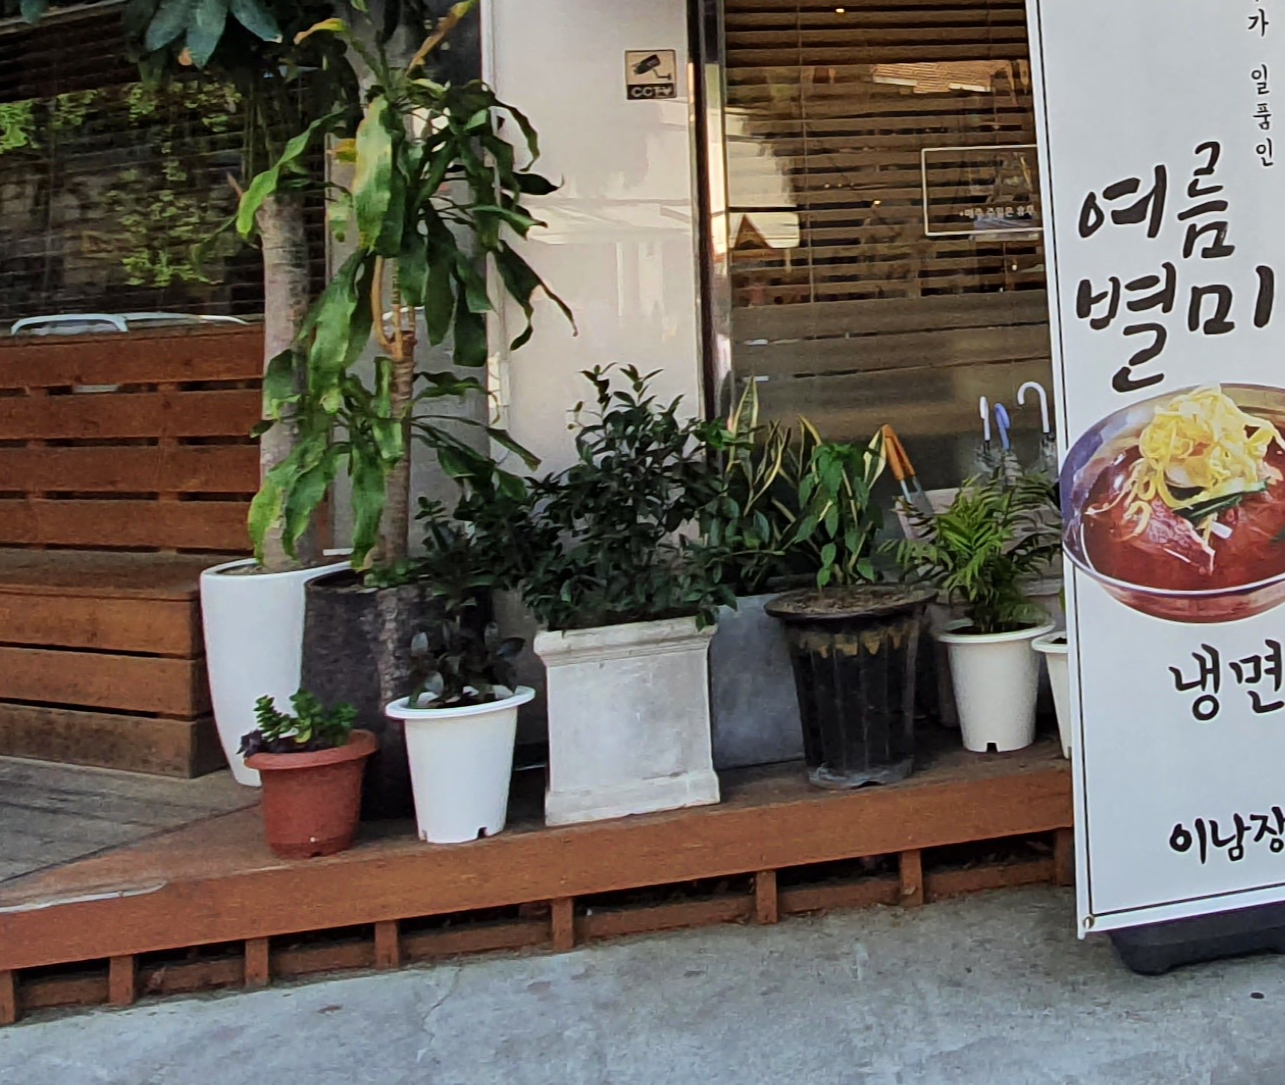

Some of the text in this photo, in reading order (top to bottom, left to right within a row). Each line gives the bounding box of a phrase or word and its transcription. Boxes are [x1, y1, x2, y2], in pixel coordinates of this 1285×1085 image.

[631, 86, 672, 97] CCTV
[1251, 65, 1274, 167] 일품인
[1078, 141, 1235, 259] 여름
[1169, 639, 1285, 721] 냉면
